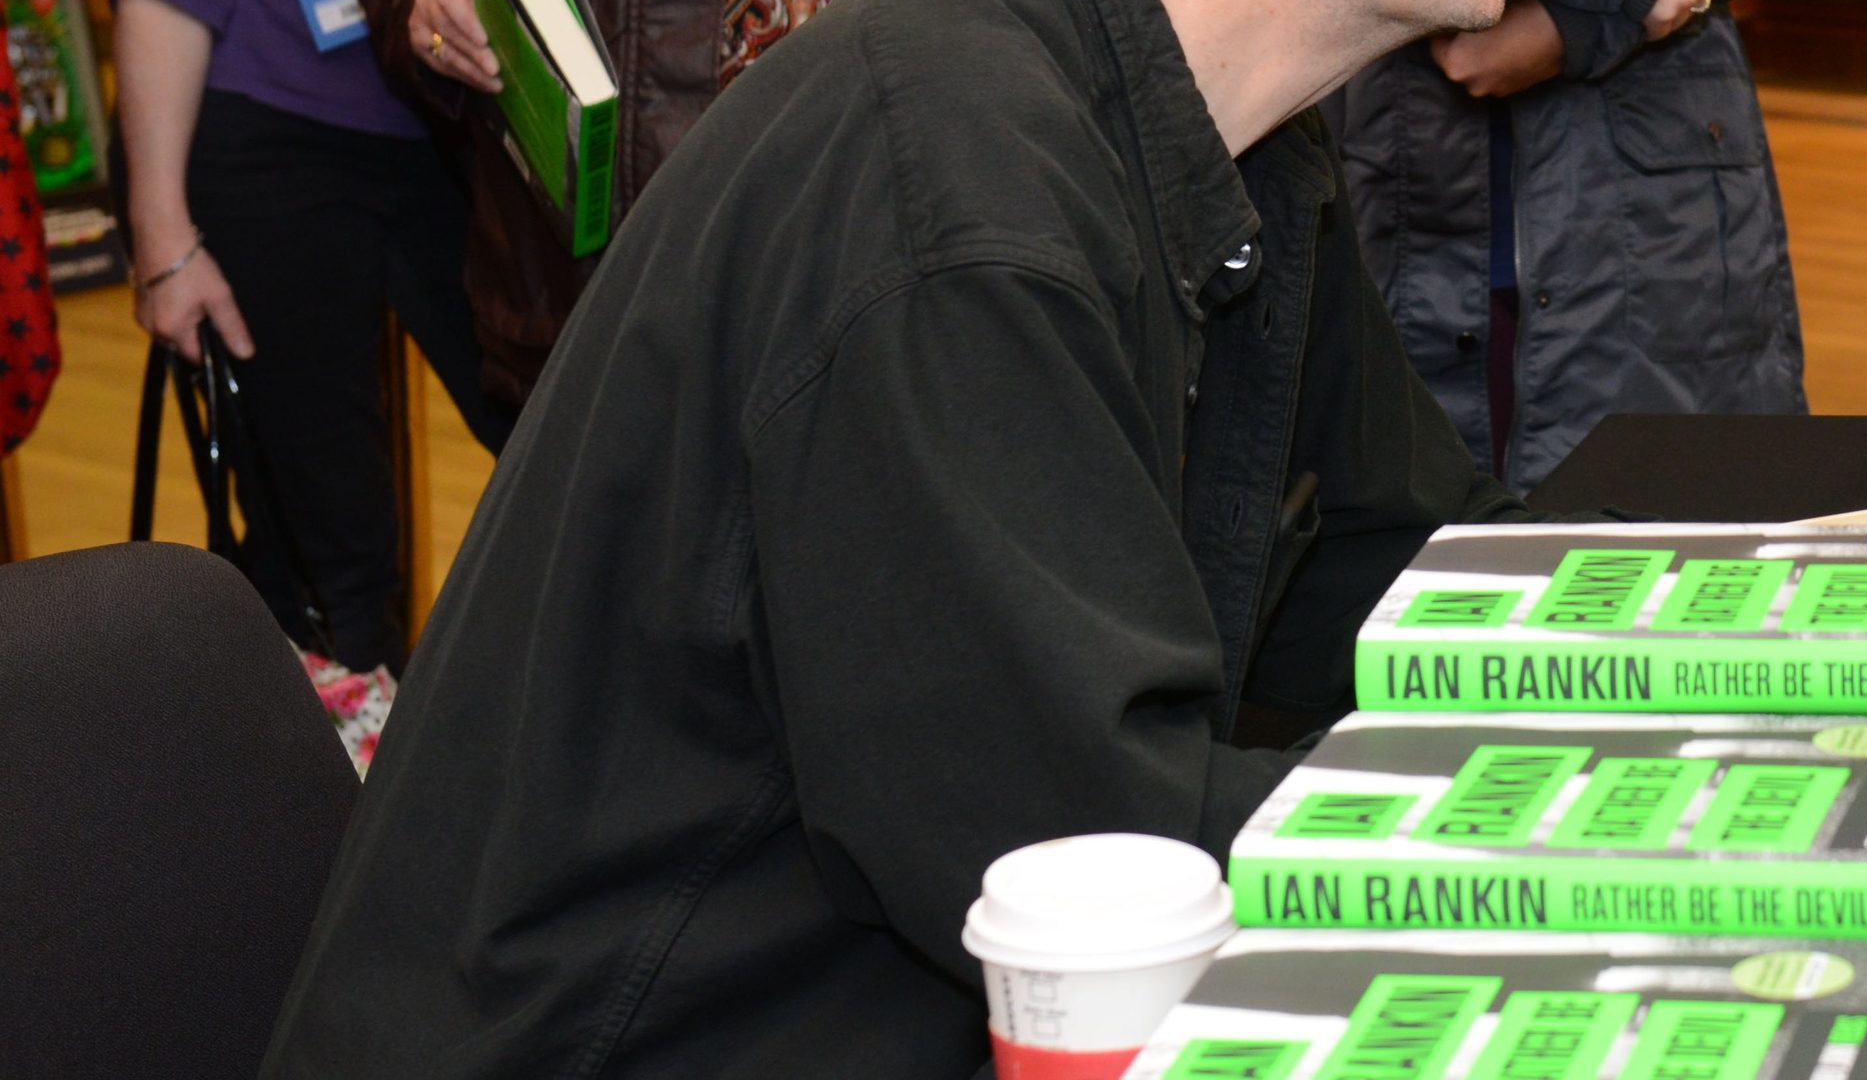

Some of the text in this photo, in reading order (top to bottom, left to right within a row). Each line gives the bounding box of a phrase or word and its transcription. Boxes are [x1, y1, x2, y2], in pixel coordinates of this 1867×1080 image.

[1417, 591, 1506, 623] IAN
[1545, 554, 1653, 624] RANKIN
[1681, 565, 1763, 623] RATHER BE
[1387, 655, 1460, 700] IAN
[1483, 655, 1652, 701] RANKIN
[1675, 661, 1771, 698] RATHER
[1783, 662, 1813, 698] BE
[1298, 796, 1399, 833] IAN
[1436, 756, 1566, 836] RANKIN
[1262, 873, 1342, 923] IAN
[1366, 874, 1547, 925] RANKIN
[1571, 884, 1677, 925] RATHER
[1688, 885, 1721, 926] BE
[1734, 886, 1784, 927] THE
